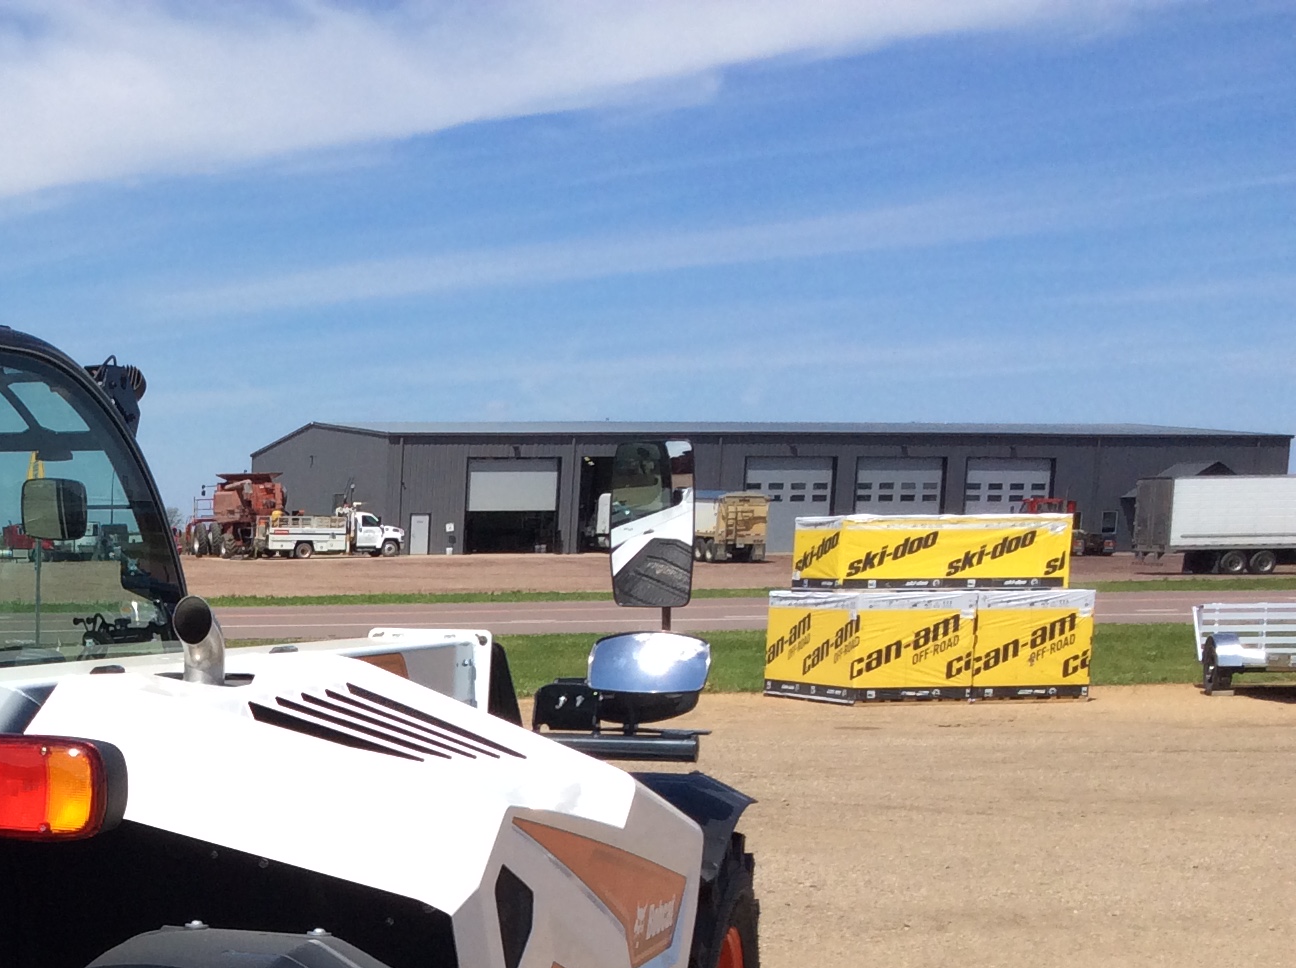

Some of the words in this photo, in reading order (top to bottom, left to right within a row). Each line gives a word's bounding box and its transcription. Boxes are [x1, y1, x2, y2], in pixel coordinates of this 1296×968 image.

[795, 531, 840, 572] ski-doo
[846, 531, 939, 577] ski-doo
[946, 530, 1037, 576] ski-doo
[802, 614, 860, 676] can-am
[849, 614, 960, 680] can-am
[912, 635, 960, 665] OFF-ROAD
[972, 612, 1076, 677] can-am
[1029, 633, 1076, 665] OFF-ROAD
